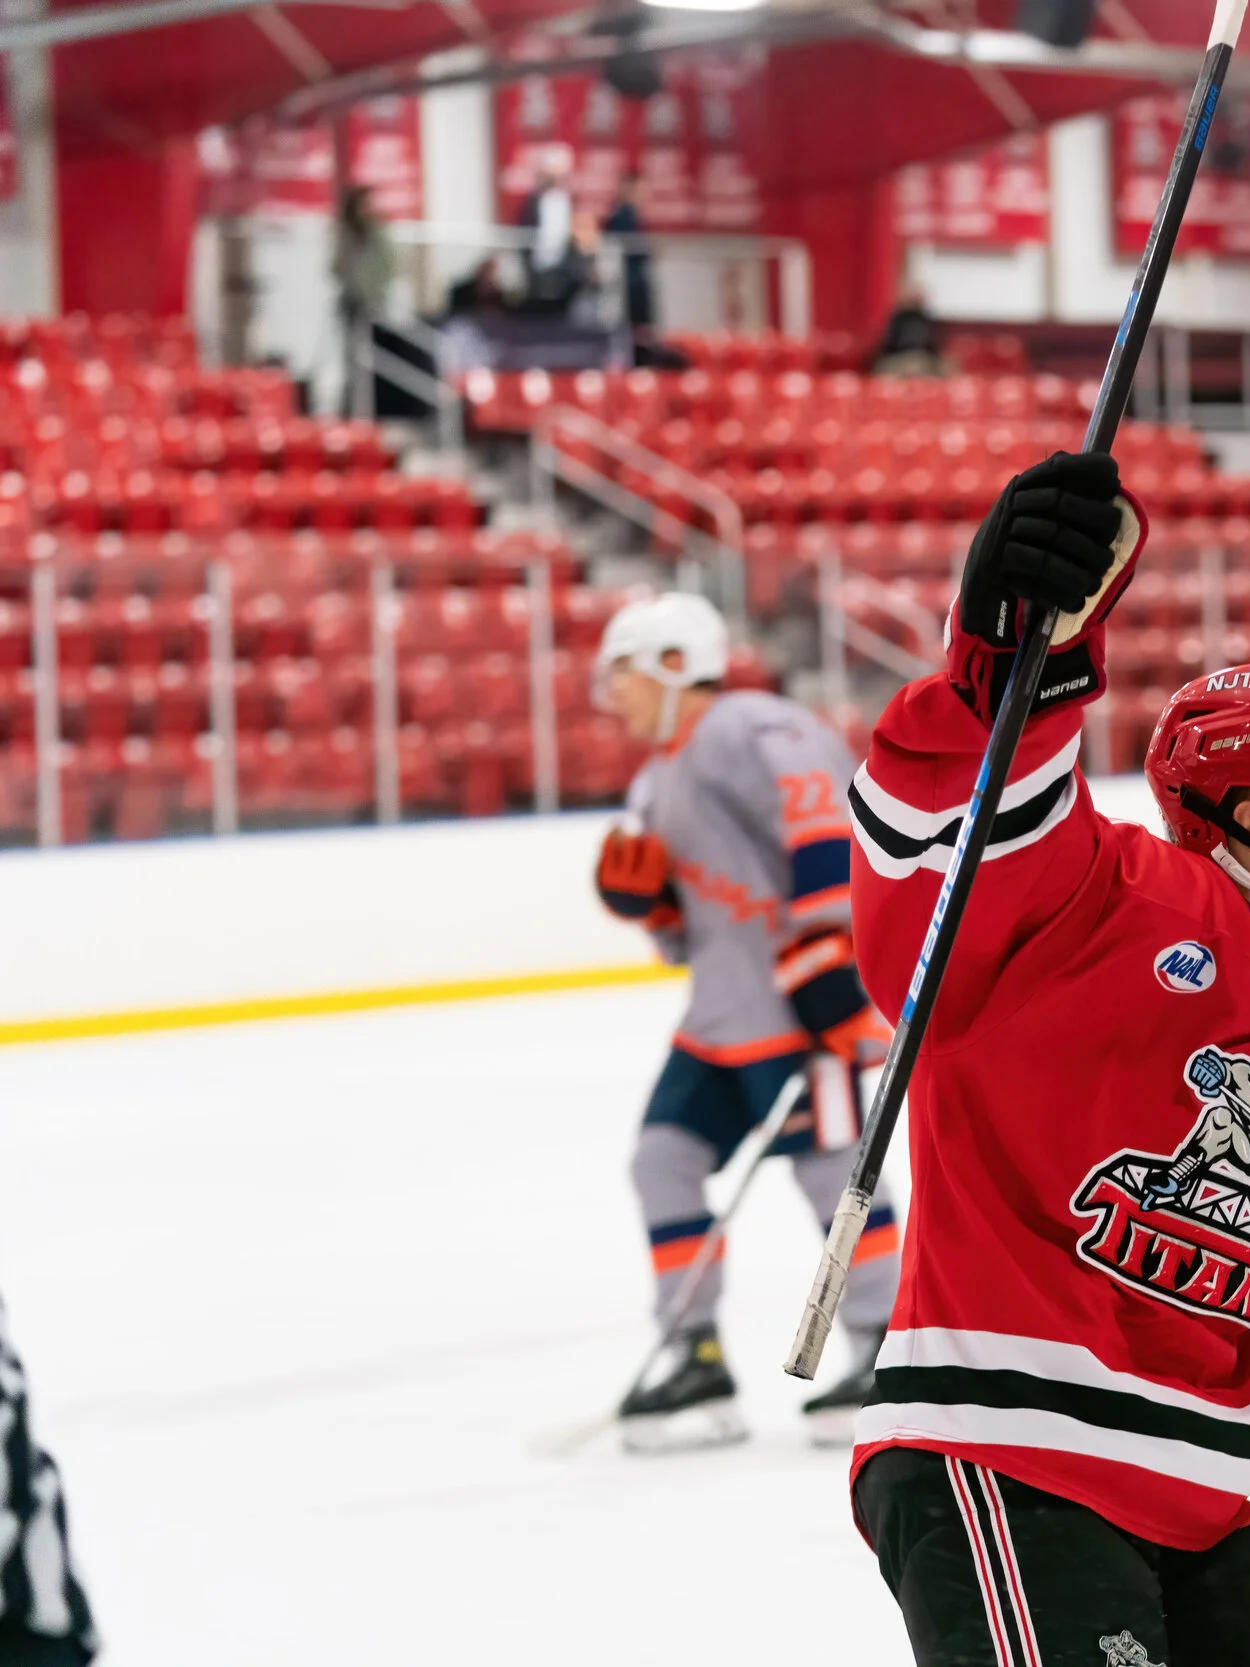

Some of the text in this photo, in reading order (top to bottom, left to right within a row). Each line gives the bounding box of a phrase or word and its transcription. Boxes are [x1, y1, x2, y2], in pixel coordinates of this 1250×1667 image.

[1195, 85, 1219, 152] BAUER
[997, 600, 1008, 638] BAUER
[1040, 676, 1089, 700] BAUER
[777, 769, 838, 823] 22
[909, 812, 974, 1002] BAUER
